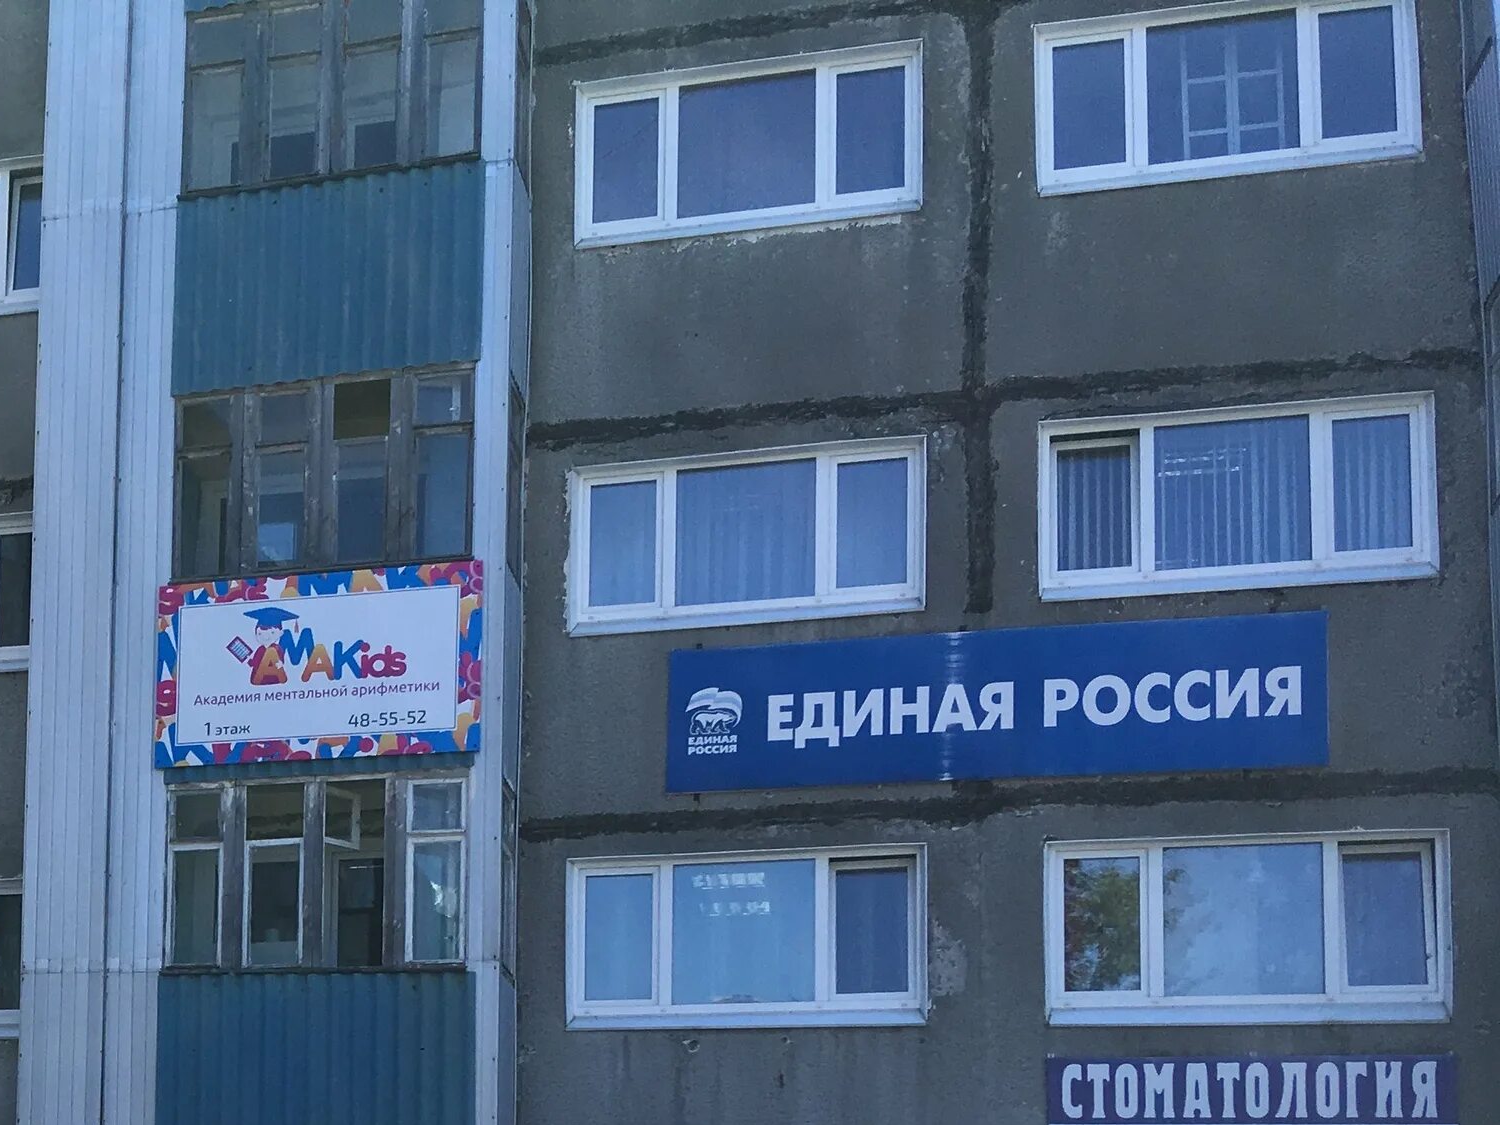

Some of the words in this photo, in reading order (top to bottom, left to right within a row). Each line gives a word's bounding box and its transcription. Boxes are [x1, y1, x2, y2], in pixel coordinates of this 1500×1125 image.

[194, 692, 261, 706] Академия
[265, 685, 349, 703] ментальной
[351, 680, 440, 698] арифметики
[766, 682, 1014, 749] ЕДИНАЯ
[1043, 665, 1302, 727] РОССИЯ
[348, 710, 427, 728] 48-55-52
[204, 722, 211, 736] 1
[215, 724, 251, 736] этаж
[687, 735, 738, 745] ЕДИНАЯ
[687, 744, 738, 755] РОССИЯ
[1061, 1061, 1438, 1119] СТОМАТОЛОГИЯ
